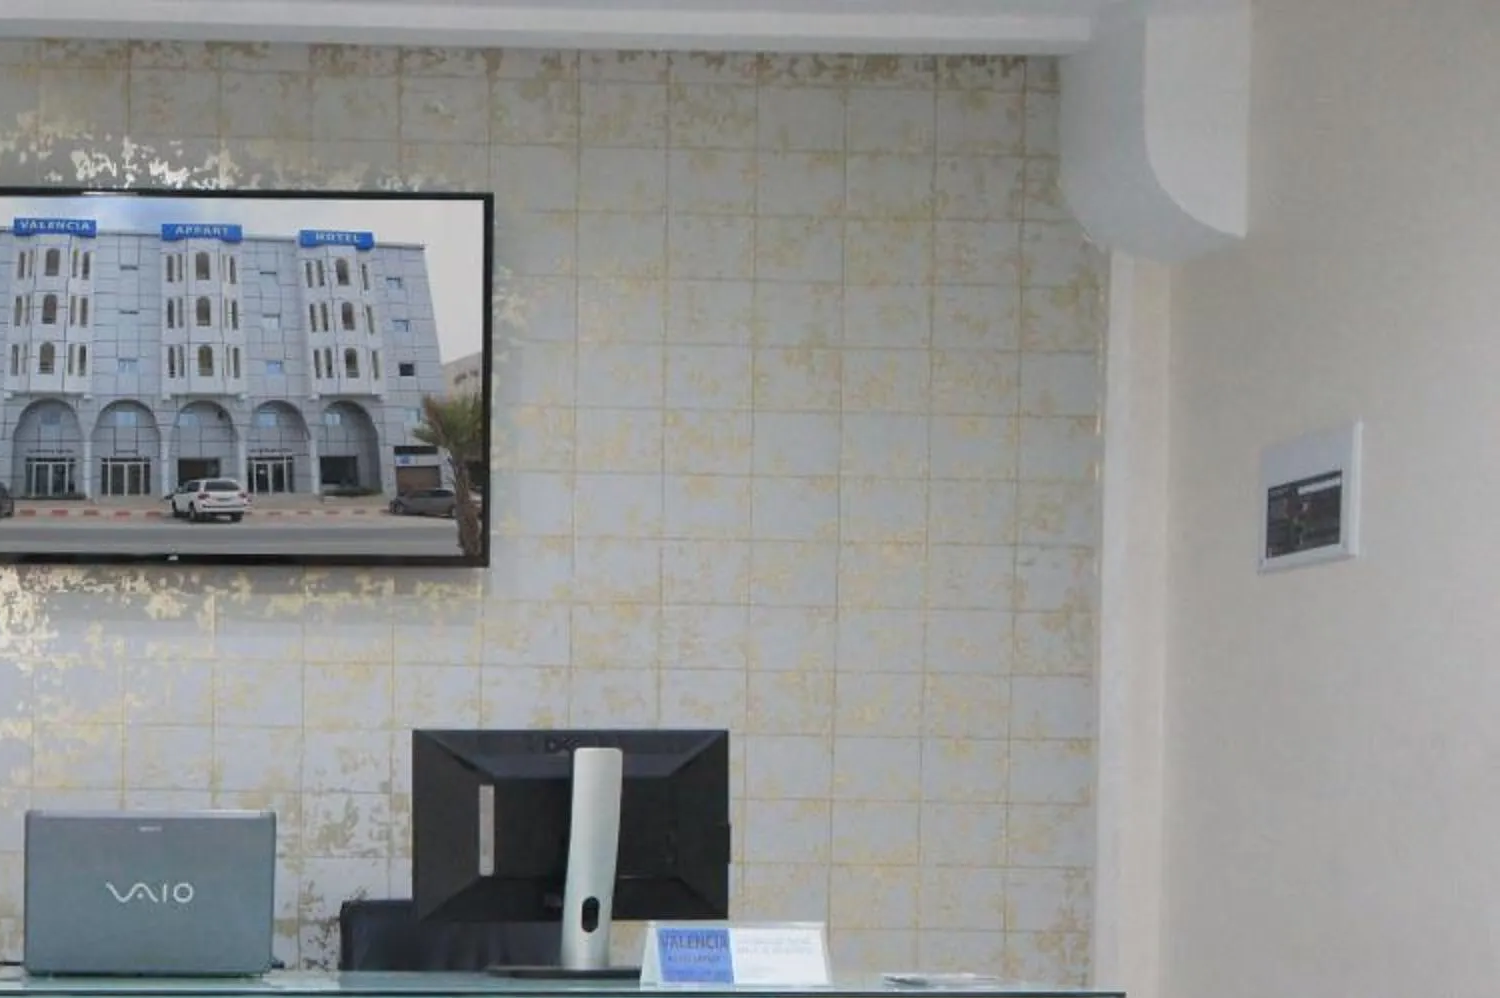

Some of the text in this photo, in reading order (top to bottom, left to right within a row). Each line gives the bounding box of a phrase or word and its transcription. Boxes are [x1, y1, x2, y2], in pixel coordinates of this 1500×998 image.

[18, 219, 361, 243] VALENCIA APPART HOTEL
[105, 882, 193, 903] VAIO
